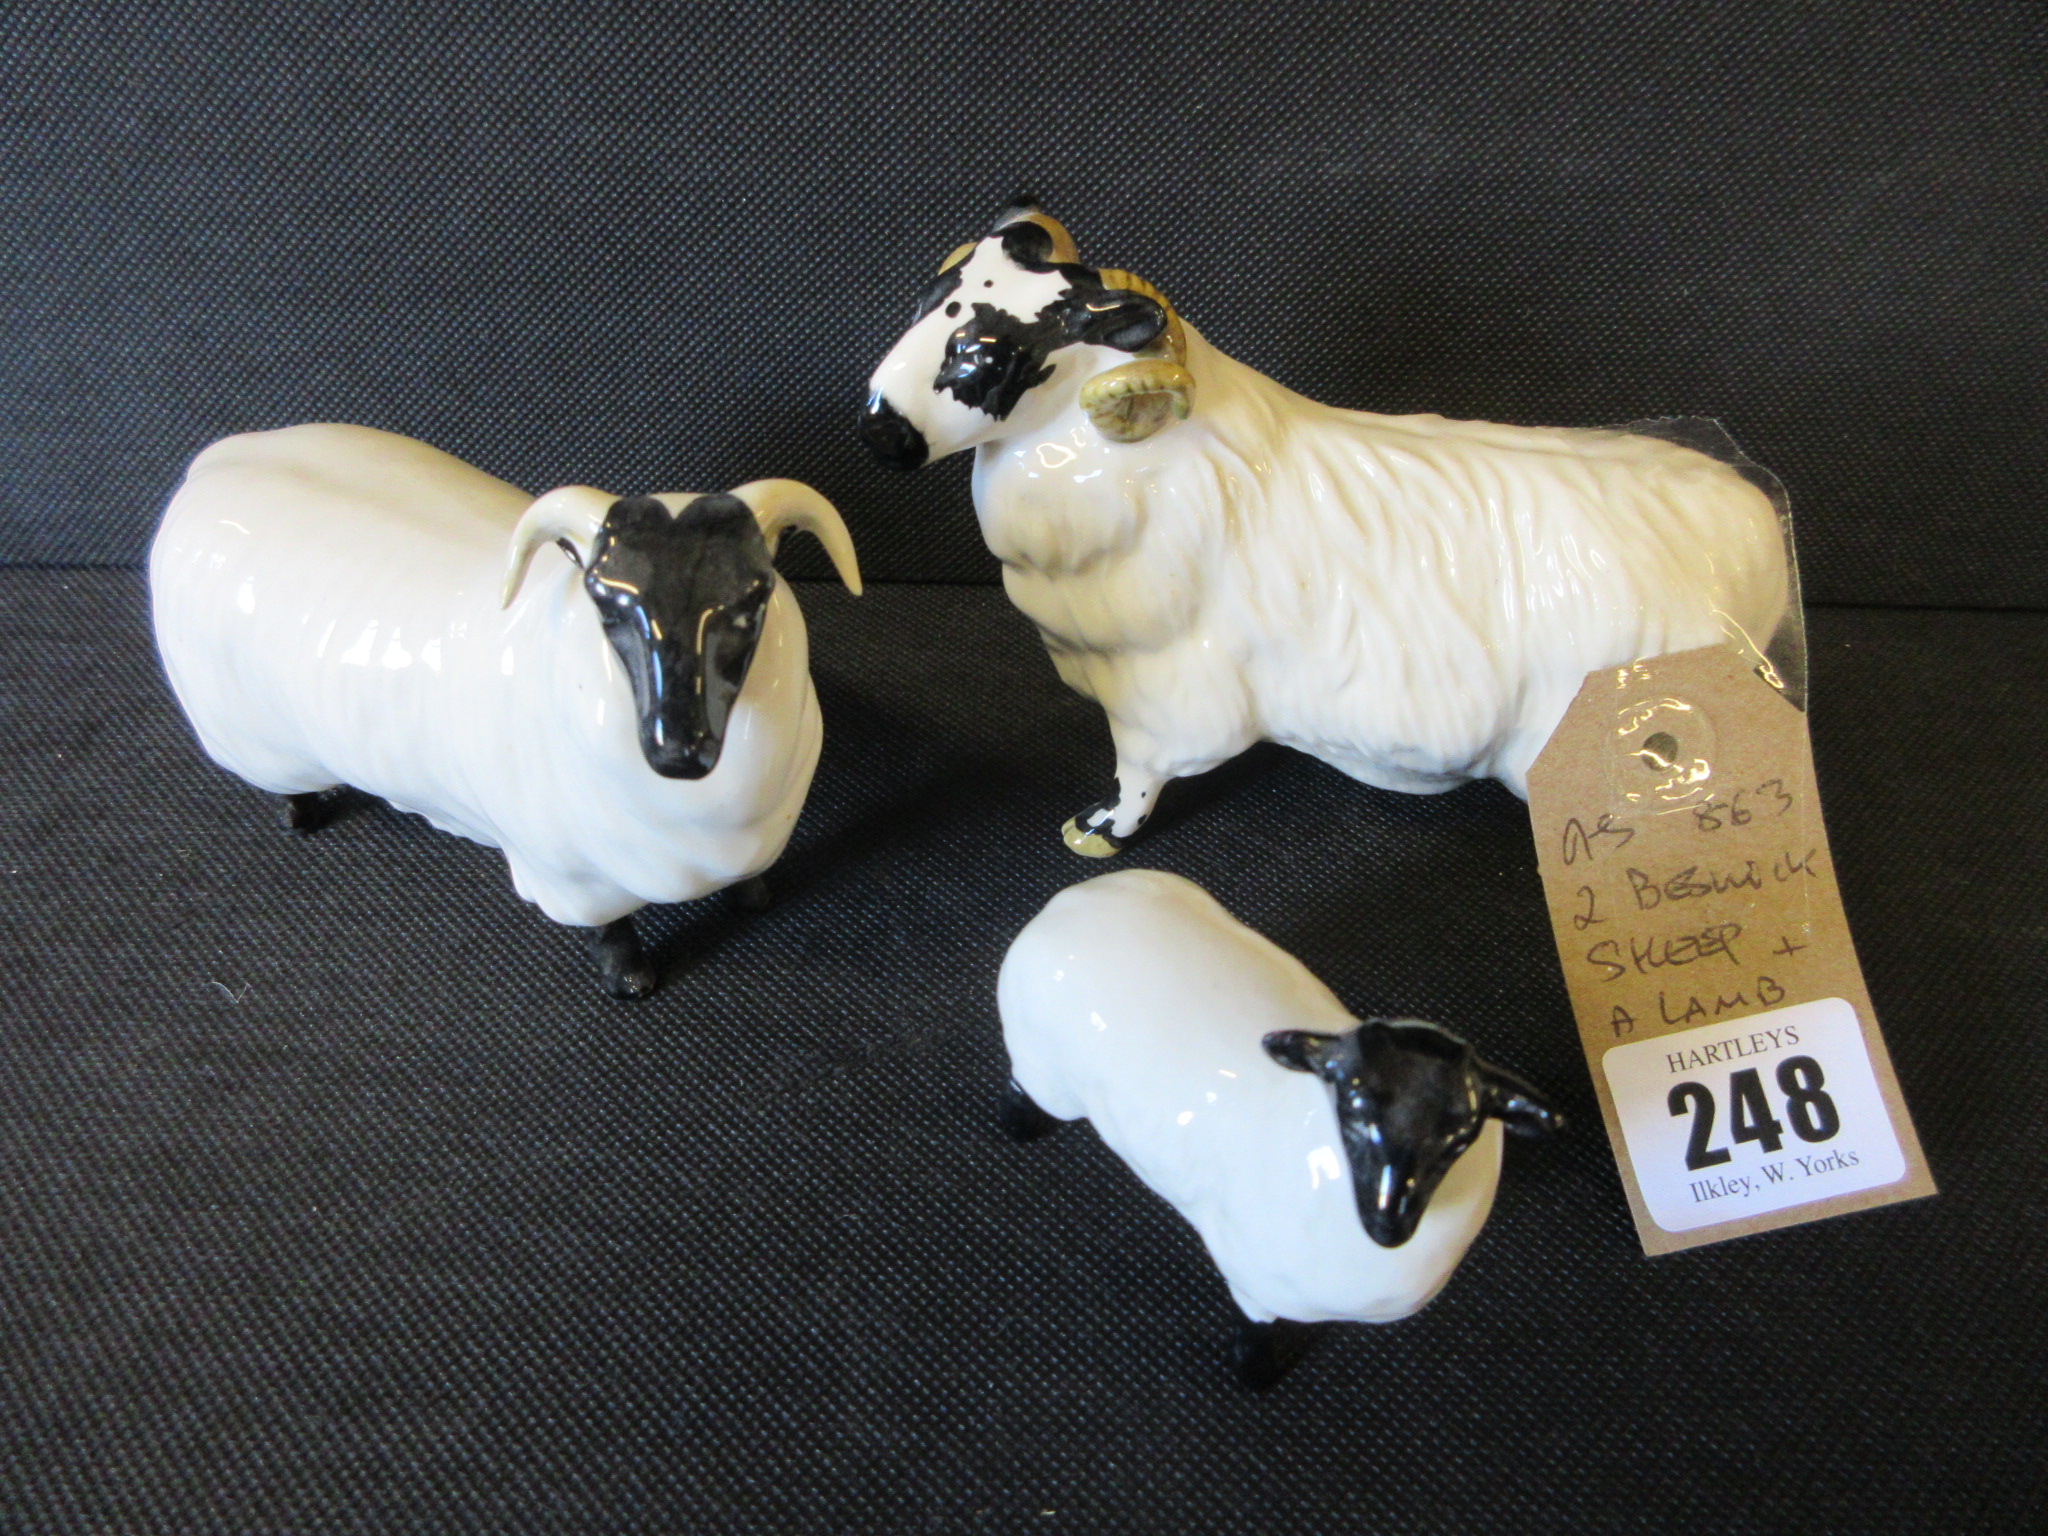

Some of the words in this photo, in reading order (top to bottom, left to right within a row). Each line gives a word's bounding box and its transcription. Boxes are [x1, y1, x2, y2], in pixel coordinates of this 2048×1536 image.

[1692, 778, 1793, 832] 863
[1574, 886, 1603, 931] 2
[1586, 922, 1742, 982] SHEEP
[1611, 1004, 1634, 1037] A
[1659, 976, 1786, 1025] LAMB
[1666, 1025, 1800, 1073] HARTLEYS
[1667, 1054, 1840, 1172] 248
[1690, 1176, 1760, 1204] Ilkley,
[1761, 1162, 1794, 1184] W.
[1795, 1149, 1860, 1177] Yorks
